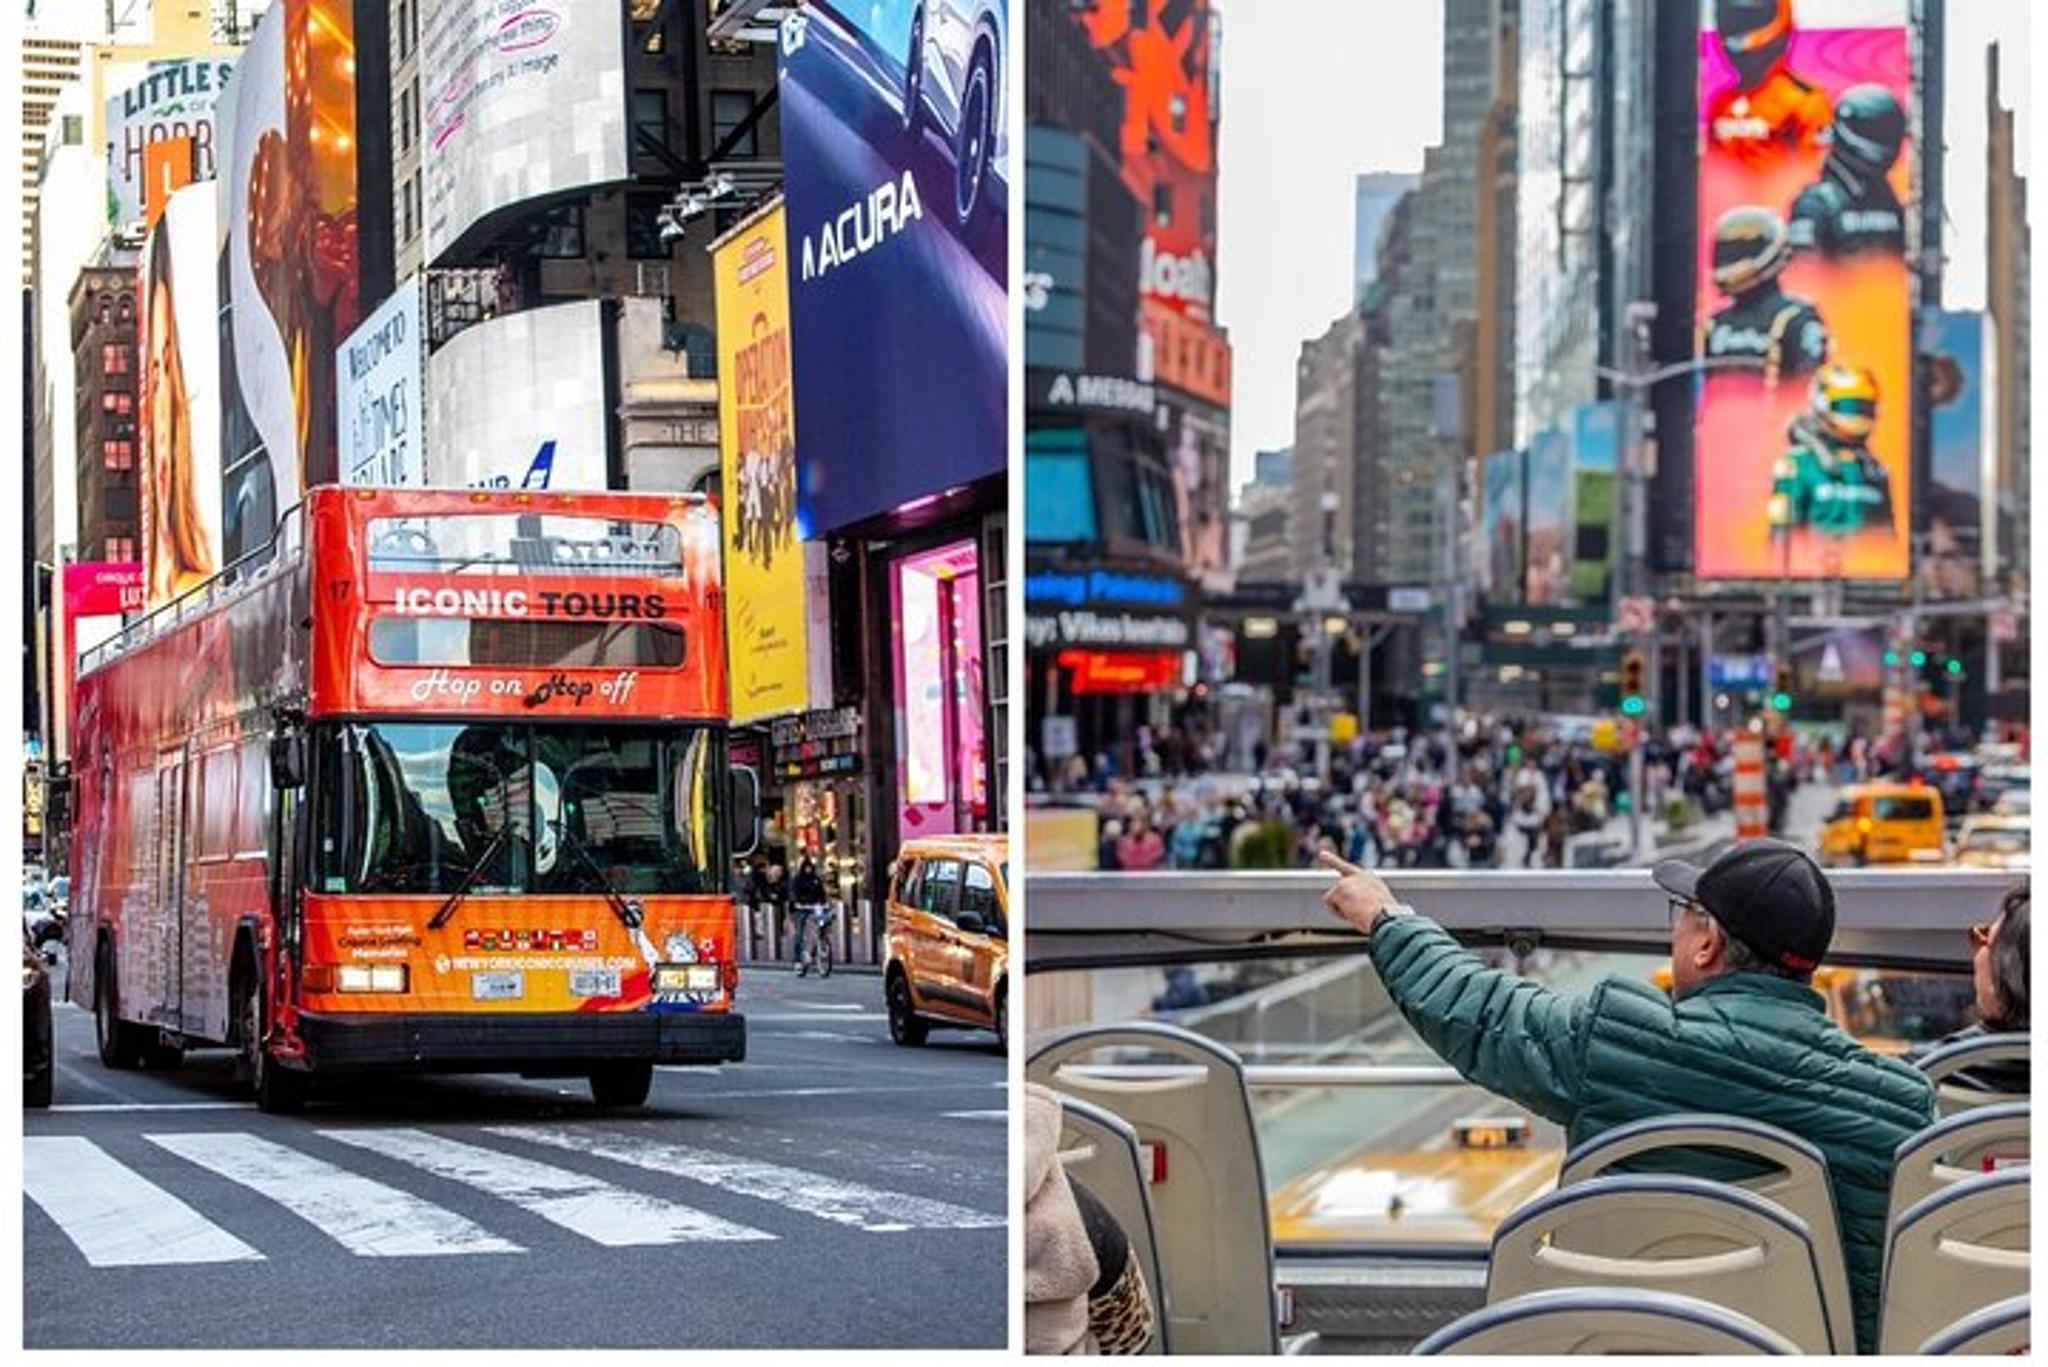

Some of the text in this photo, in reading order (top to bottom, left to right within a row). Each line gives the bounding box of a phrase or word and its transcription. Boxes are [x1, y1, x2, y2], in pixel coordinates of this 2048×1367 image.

[124, 61, 212, 118] LITTLE
[818, 169, 922, 277] ACURA
[667, 422, 708, 441] THE
[330, 580, 351, 599] 17
[394, 588, 666, 618] ICONIC TOURS
[410, 670, 637, 706] Hop on Hop off
